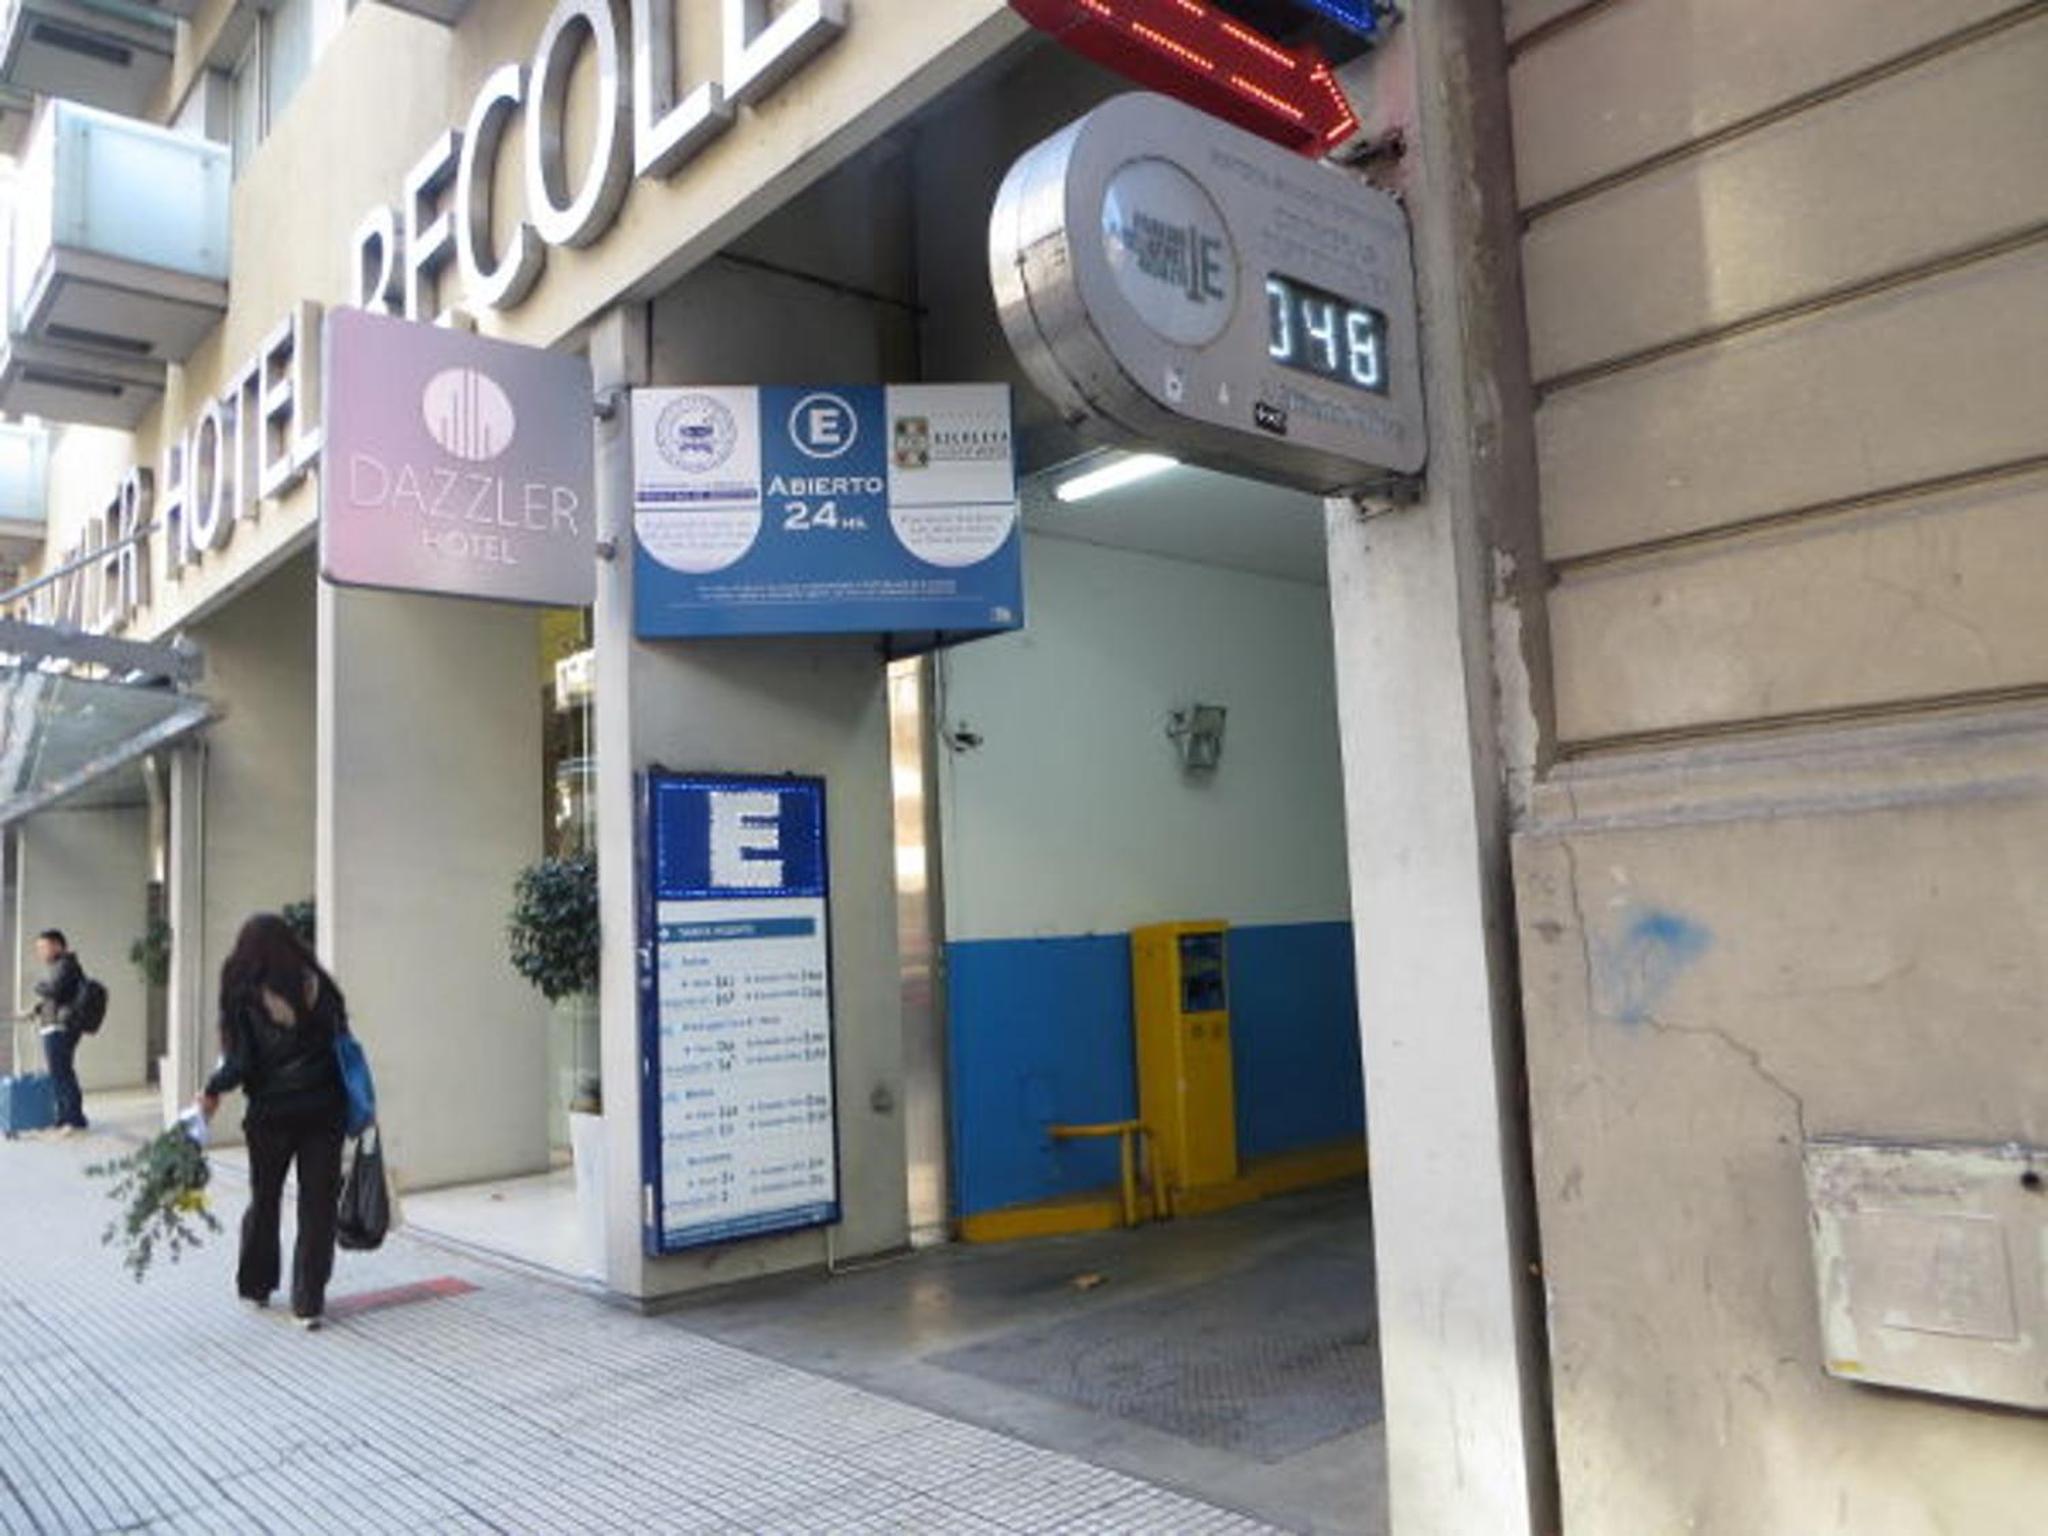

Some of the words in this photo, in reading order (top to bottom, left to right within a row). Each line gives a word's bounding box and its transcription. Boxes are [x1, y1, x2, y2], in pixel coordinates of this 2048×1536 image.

[161, 298, 326, 582] HOTEL
[809, 408, 841, 444] E
[348, 451, 579, 536] DAZZLER
[784, 501, 838, 530] 24
[421, 528, 520, 565] HOTEL
[709, 791, 784, 888] E
